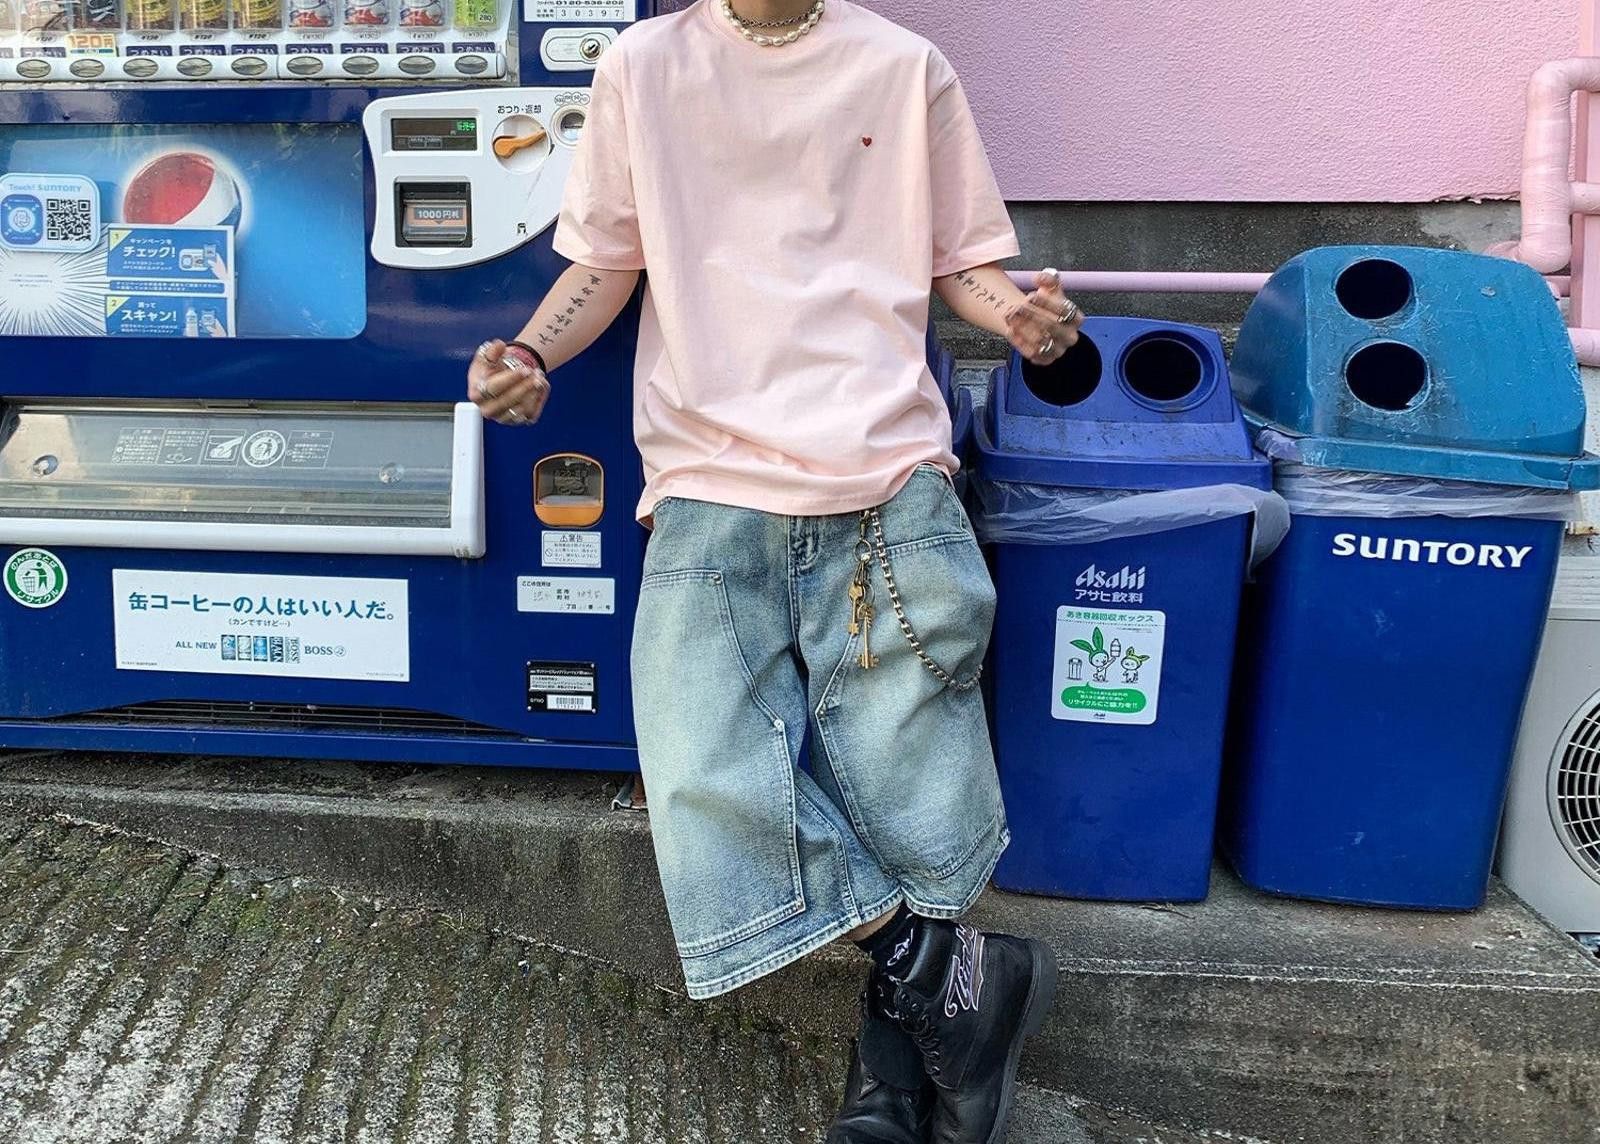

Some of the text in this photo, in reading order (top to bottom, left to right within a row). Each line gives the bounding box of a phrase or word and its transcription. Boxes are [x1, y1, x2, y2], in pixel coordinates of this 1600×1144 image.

[498, 105, 541, 114] おつり・返却
[123, 246, 176, 258] チェック!
[121, 309, 177, 321] スキャン!
[1332, 532, 1533, 568] SUNTORY
[1075, 563, 1146, 590] Asahi
[1075, 588, 1144, 604] アサヒ飲料
[128, 591, 394, 621] 缶コーヒーの人はいい人だ。
[1066, 610, 1154, 623] あき容器回収ボックス
[175, 640, 218, 650] ALL NEW
[304, 645, 333, 656] BOSS
